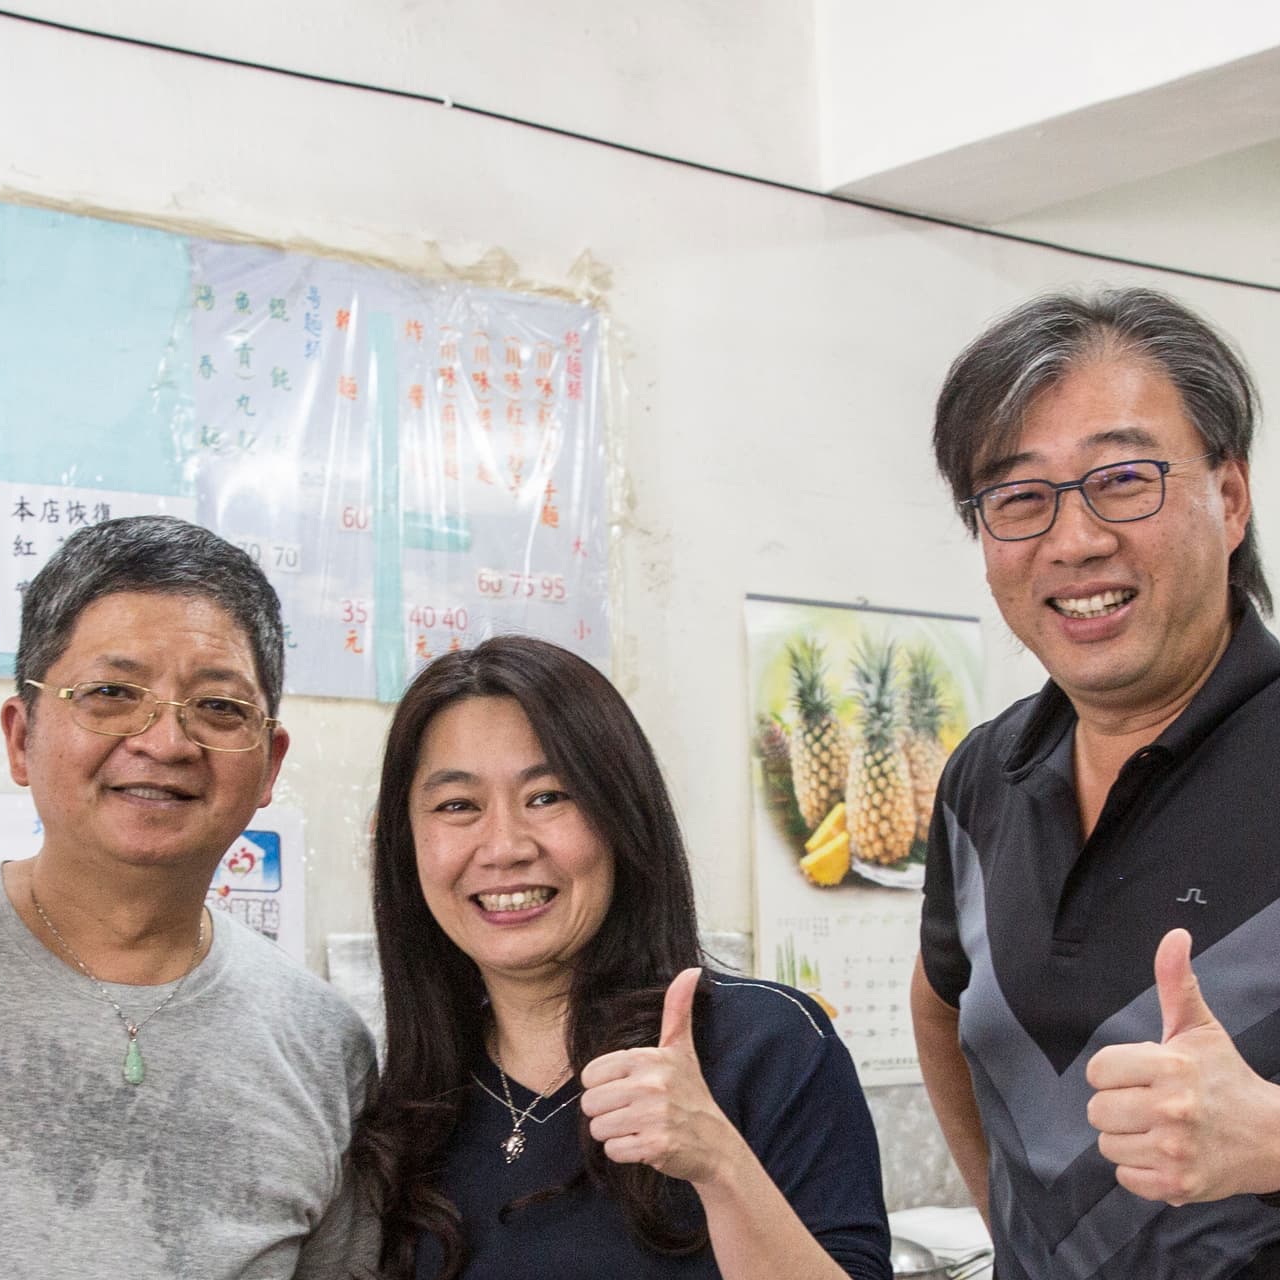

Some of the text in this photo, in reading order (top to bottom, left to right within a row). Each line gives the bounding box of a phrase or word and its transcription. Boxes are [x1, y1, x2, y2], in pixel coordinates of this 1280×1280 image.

[342, 507, 368, 530] 60
[573, 536, 587, 556] 大
[275, 547, 298, 569] 70
[477, 574, 503, 595] 60
[509, 574, 534, 598] 75
[540, 576, 566, 599] 95
[342, 600, 368, 624] 35
[409, 607, 437, 629] 40
[442, 608, 468, 631] 40
[574, 620, 592, 640] 小
[345, 630, 364, 654] 元
[415, 635, 433, 658] 元
